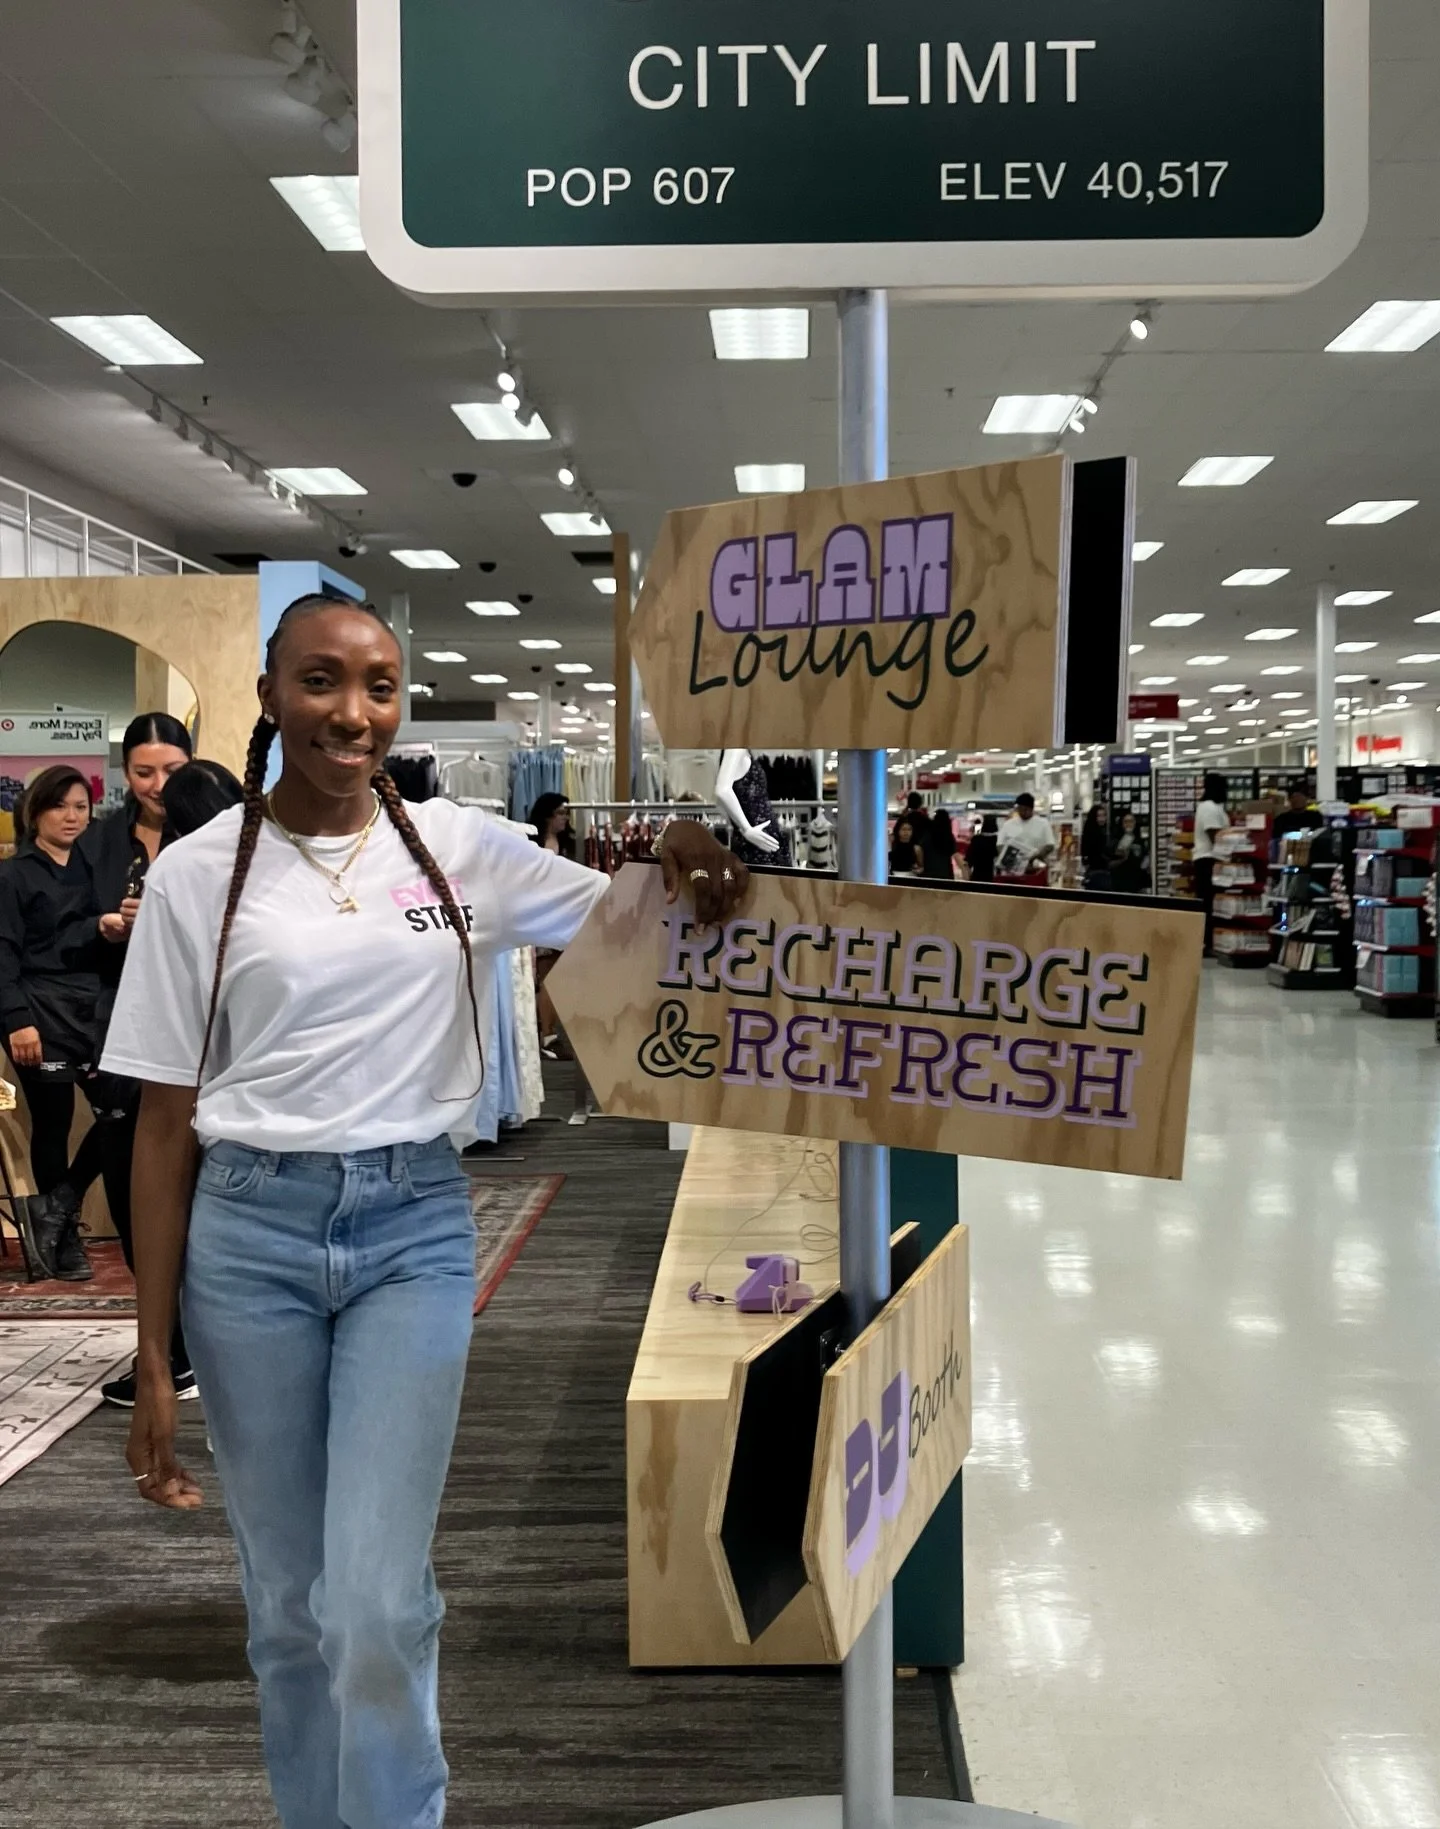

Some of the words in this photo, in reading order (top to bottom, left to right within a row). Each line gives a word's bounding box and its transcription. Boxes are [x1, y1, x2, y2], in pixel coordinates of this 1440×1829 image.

[628, 44, 828, 110] CITY
[867, 40, 1097, 105] LIMIT
[526, 168, 632, 207] POP
[653, 167, 737, 205] 607
[939, 161, 1067, 200] ELEV
[1087, 160, 1230, 205] 40,517
[711, 512, 954, 633] GLAM
[690, 609, 989, 711] Lounge
[404, 904, 474, 932] STAF
[657, 914, 1149, 1035] RECHARGE
[638, 999, 720, 1079] &
[721, 1006, 1143, 1128] REFRESH
[909, 1329, 963, 1459] Booth
